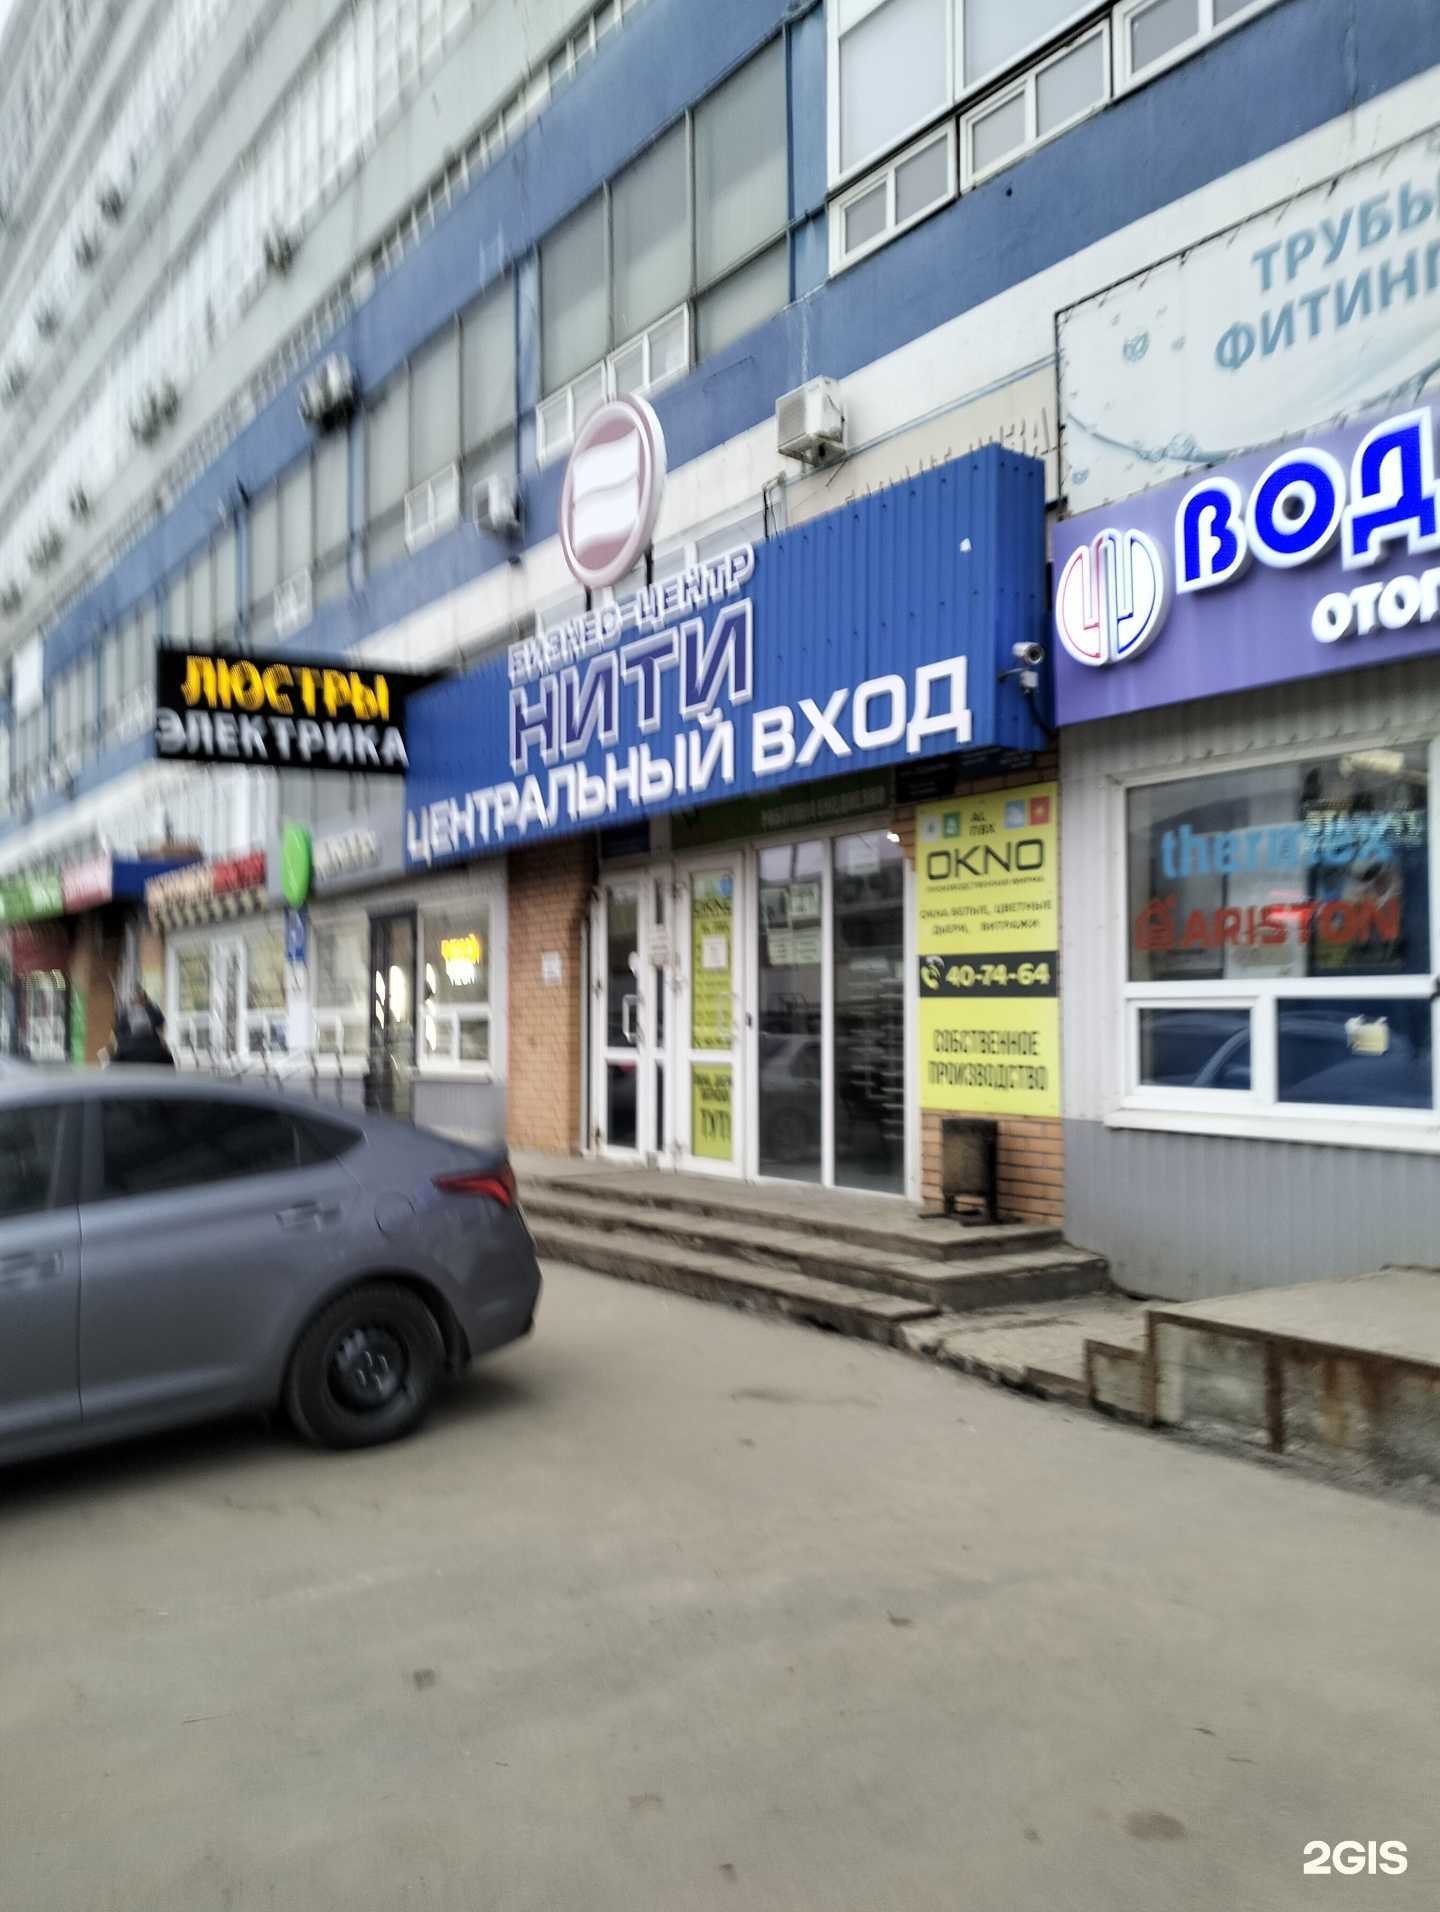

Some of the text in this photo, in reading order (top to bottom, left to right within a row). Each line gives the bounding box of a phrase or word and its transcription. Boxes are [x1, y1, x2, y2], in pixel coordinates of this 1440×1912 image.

[181, 655, 390, 721] ЛЮСТРЫ
[509, 597, 753, 776] НИТИ
[154, 706, 409, 767] ЭЛЕКТРИКА
[405, 655, 973, 867] ЦЕНТРАЛЬНЫЙ ВХОД
[927, 838, 1044, 880] OKNO
[1182, 896, 1399, 950] ARISTON
[945, 963, 1050, 988] 40-74-64
[933, 1029, 1039, 1056] СОБСТВЕННОЕ
[928, 1060, 1048, 1091] ПРОИЗВОДСТВО
